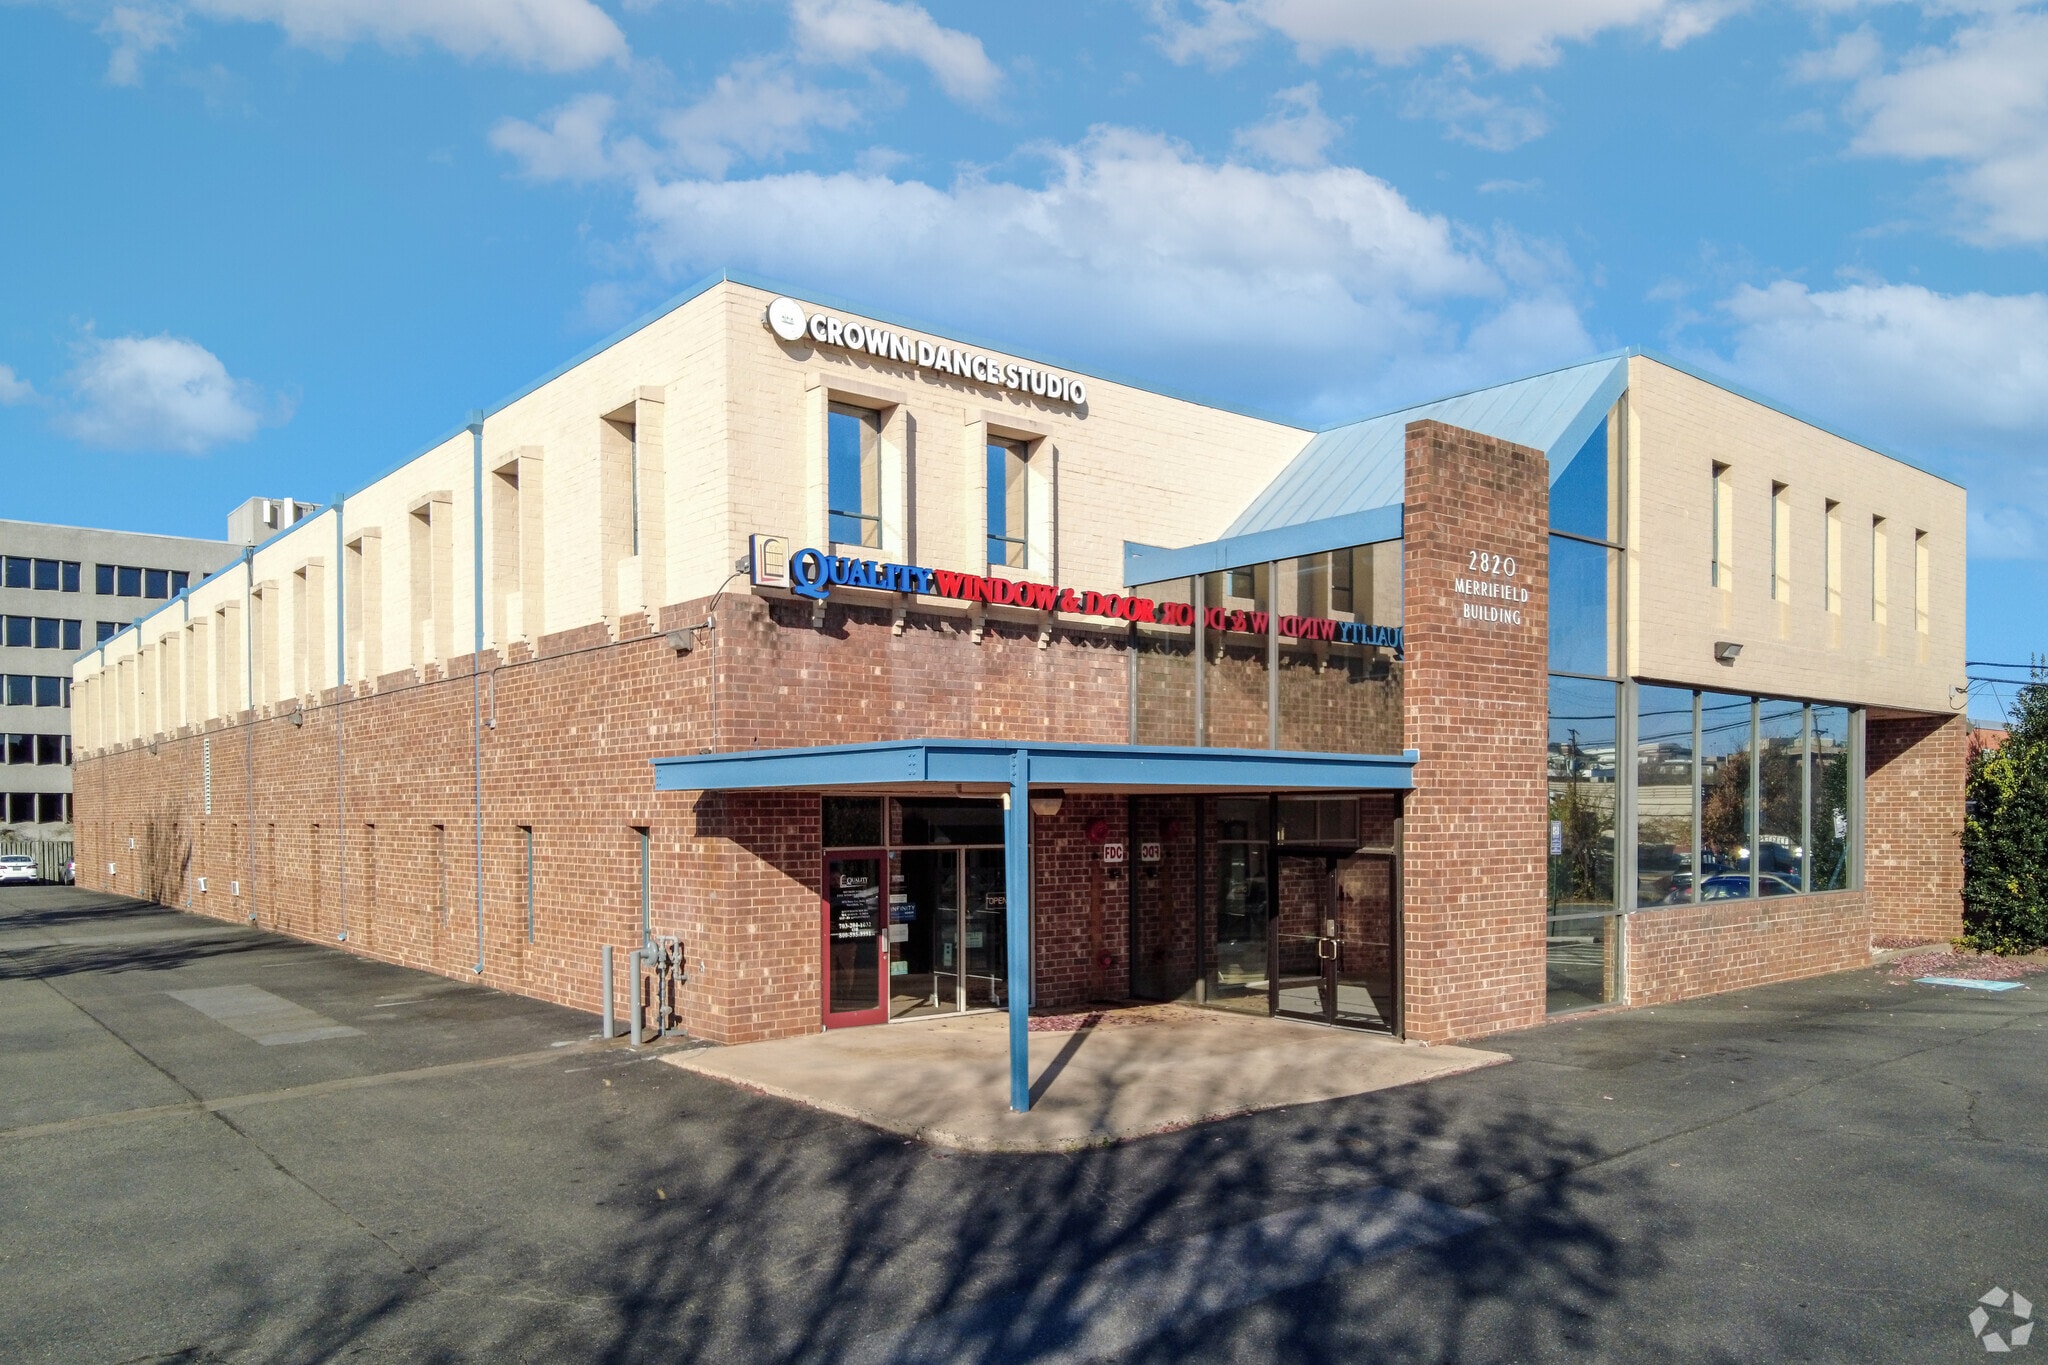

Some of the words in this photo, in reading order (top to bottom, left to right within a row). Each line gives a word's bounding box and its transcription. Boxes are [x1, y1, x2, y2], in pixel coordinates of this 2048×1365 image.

[808, 313, 910, 363] CROWN
[917, 340, 1000, 385] DANCE
[1004, 363, 1087, 405] STUDIO
[1468, 550, 1516, 577] 2820
[791, 547, 933, 599] QUALITY
[933, 569, 1060, 611] WINDOW
[1060, 587, 1082, 613] &
[1082, 590, 1156, 623] DOOR
[1454, 578, 1529, 603] MERRIFIELD
[1463, 603, 1521, 625] BUILDING
[1104, 846, 1123, 859] FDC
